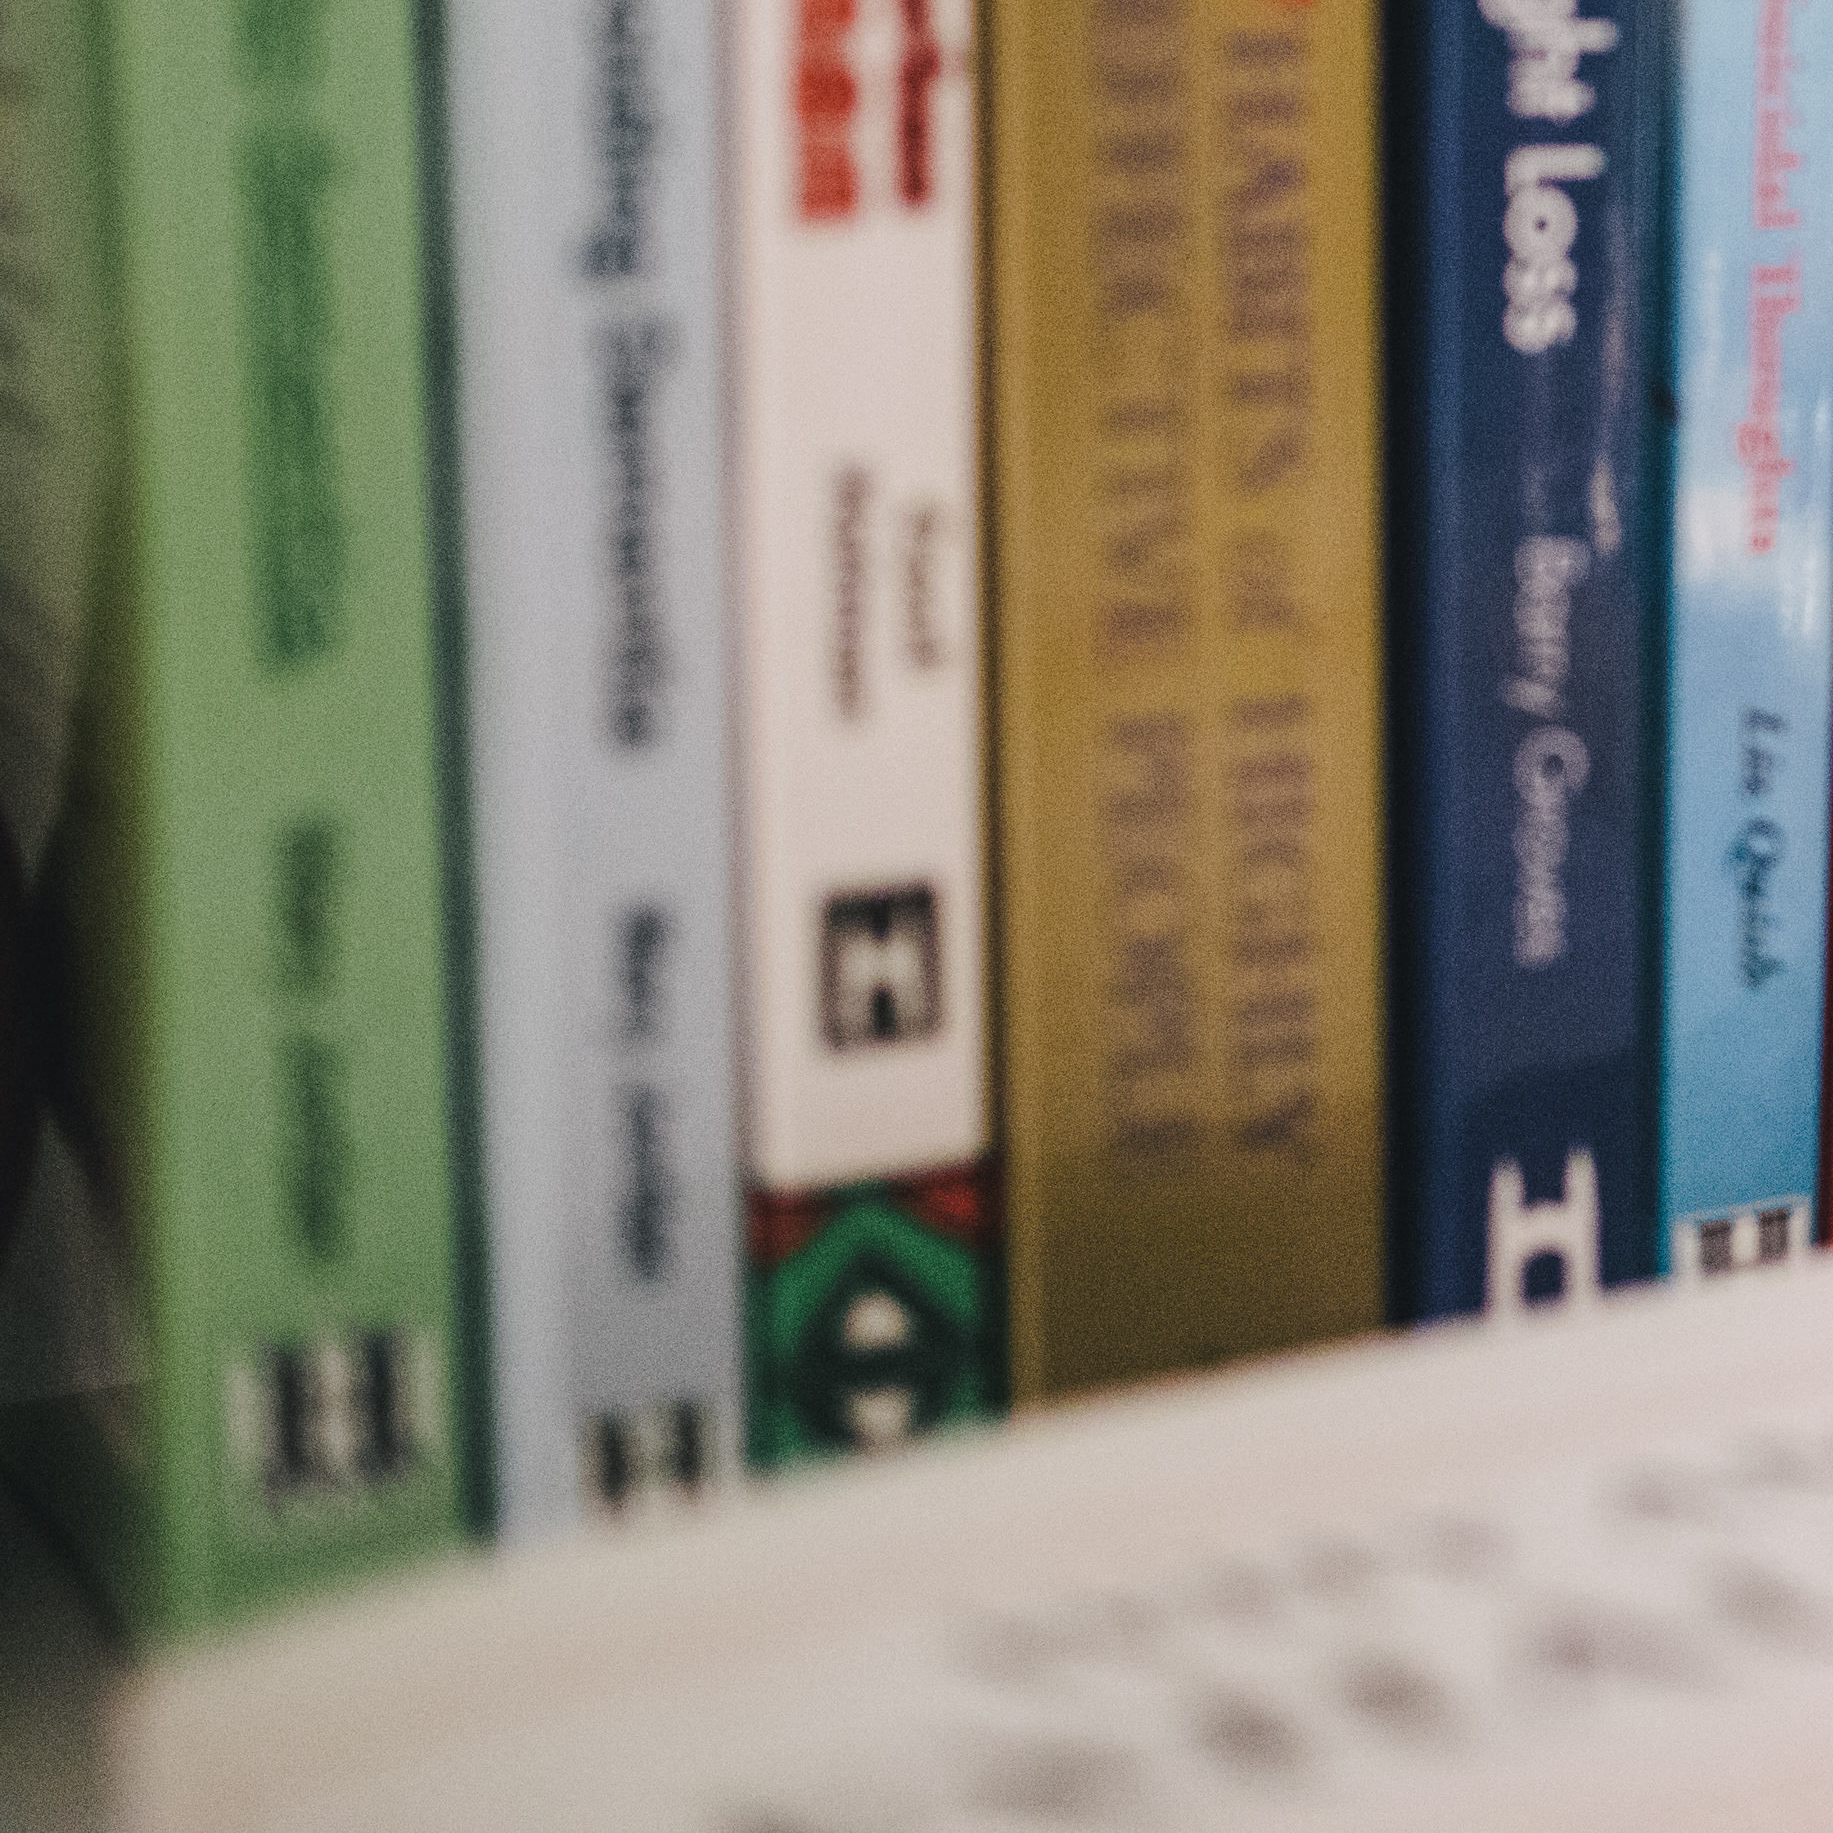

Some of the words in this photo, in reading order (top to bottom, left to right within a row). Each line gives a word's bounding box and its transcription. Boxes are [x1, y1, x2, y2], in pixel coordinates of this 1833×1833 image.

[1222, 26, 1317, 504] HABITS
[1499, 142, 1609, 355] Loss
[1731, 244, 1804, 559] Thoughts
[1228, 689, 1319, 1158] HIGHLY
